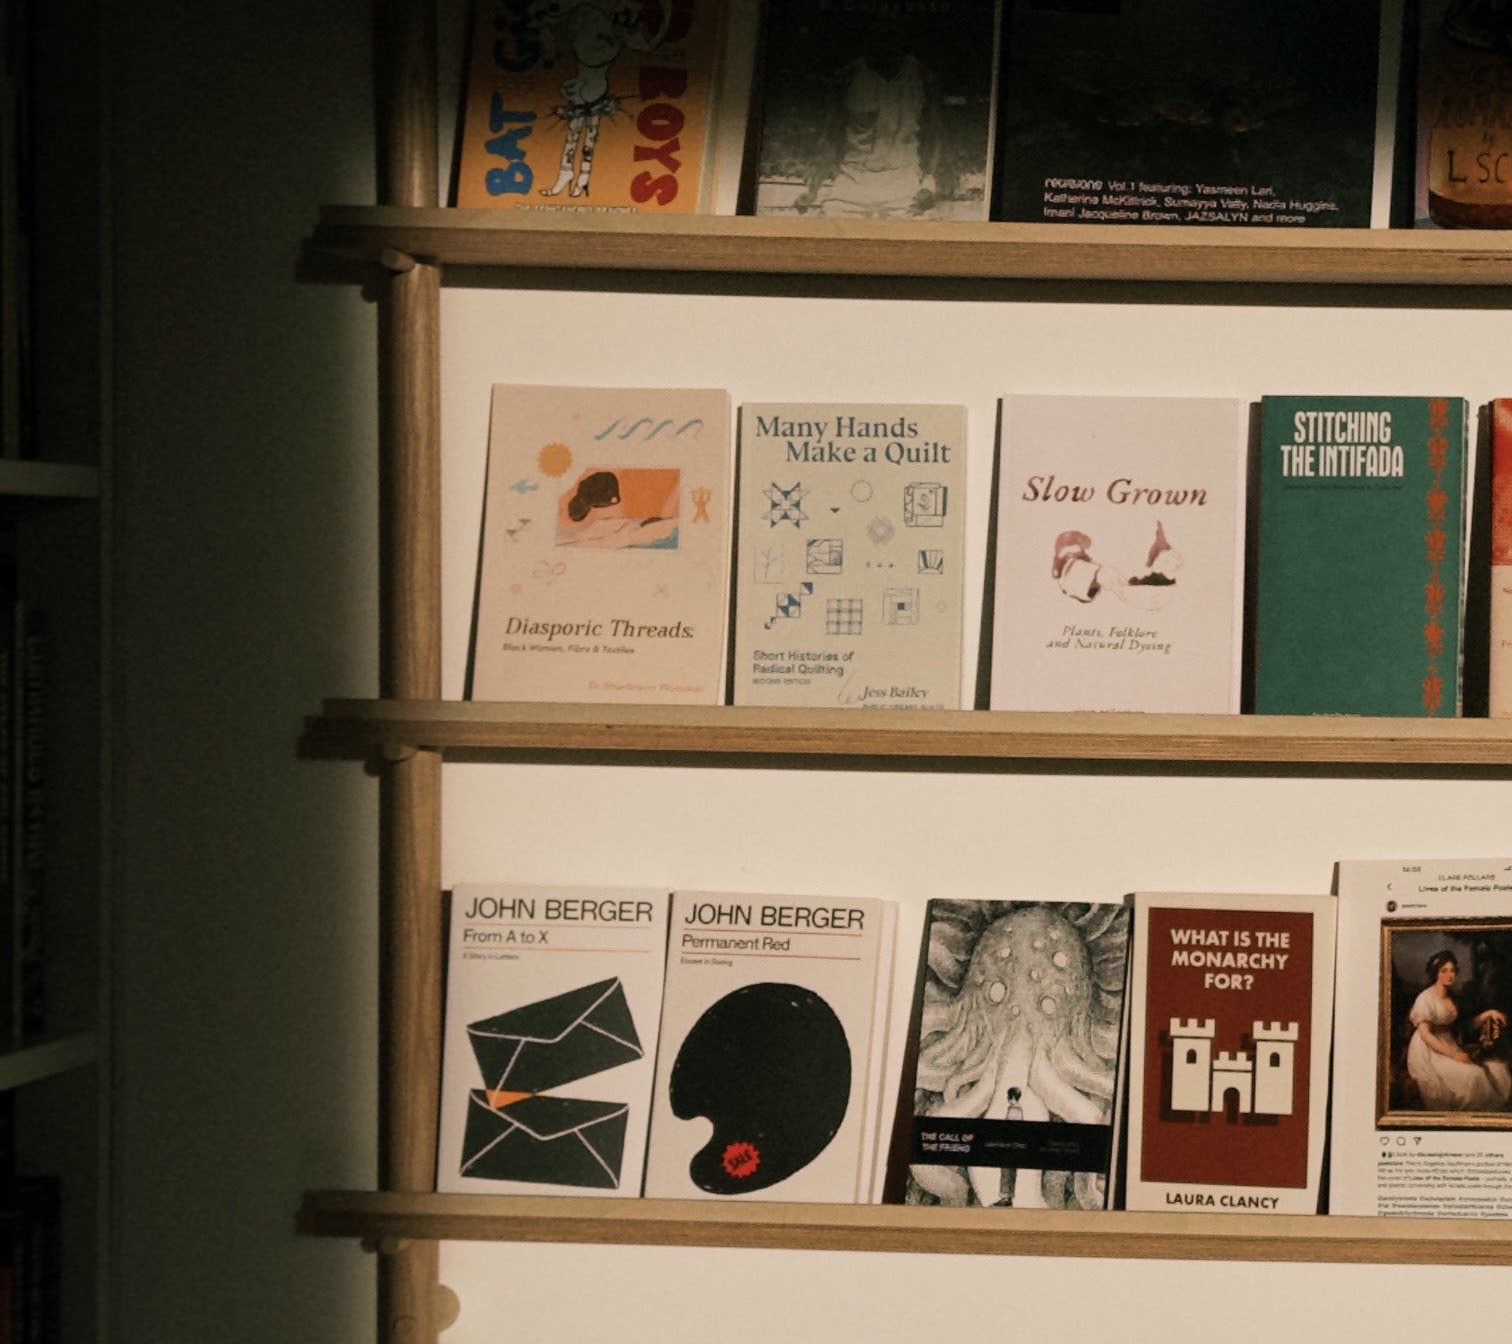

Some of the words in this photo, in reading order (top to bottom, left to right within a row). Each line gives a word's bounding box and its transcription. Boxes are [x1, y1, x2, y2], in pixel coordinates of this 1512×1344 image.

[485, 91, 536, 196] BAT
[631, 66, 688, 206] BOYS
[1447, 150, 1467, 183] L
[756, 416, 828, 443] Many
[836, 416, 919, 438] Hands
[1294, 411, 1391, 444] STITCHING
[786, 440, 856, 463] Make
[863, 445, 876, 463] a
[885, 441, 951, 465] Quilt
[1280, 445, 1315, 477] THE
[1319, 445, 1404, 477] INTIFADA
[1022, 475, 1095, 502] Slow
[1107, 478, 1207, 506] Grown
[505, 616, 602, 641] Diasporic
[1108, 626, 1157, 638] Folklore
[753, 650, 784, 661] Short
[788, 650, 838, 661] Histories
[842, 651, 855, 661] of
[1046, 639, 1070, 649] and
[1077, 639, 1124, 650] Natural
[1129, 640, 1171, 654] Dyeing
[753, 663, 794, 674] Radical
[798, 664, 844, 677] Quilting
[858, 686, 887, 700] Jess
[465, 897, 535, 921] JOHN
[545, 898, 653, 922] BERGER
[685, 904, 752, 926] JOHN
[760, 906, 865, 929] BERGER
[463, 929, 502, 943] From
[505, 929, 517, 943] A
[521, 930, 535, 944] to
[537, 930, 549, 944] X
[681, 935, 759, 950] Permanent
[762, 936, 790, 951] Red
[1170, 929, 1229, 947] WHAT
[1234, 931, 1251, 947] IS
[1255, 932, 1290, 948] THE
[1171, 950, 1289, 970] MONARCHY
[1204, 973, 1254, 990] FOR?
[938, 1132, 960, 1142] CALL
[1166, 1193, 1215, 1206] LAURA
[1220, 1195, 1279, 1209] CLANCY
